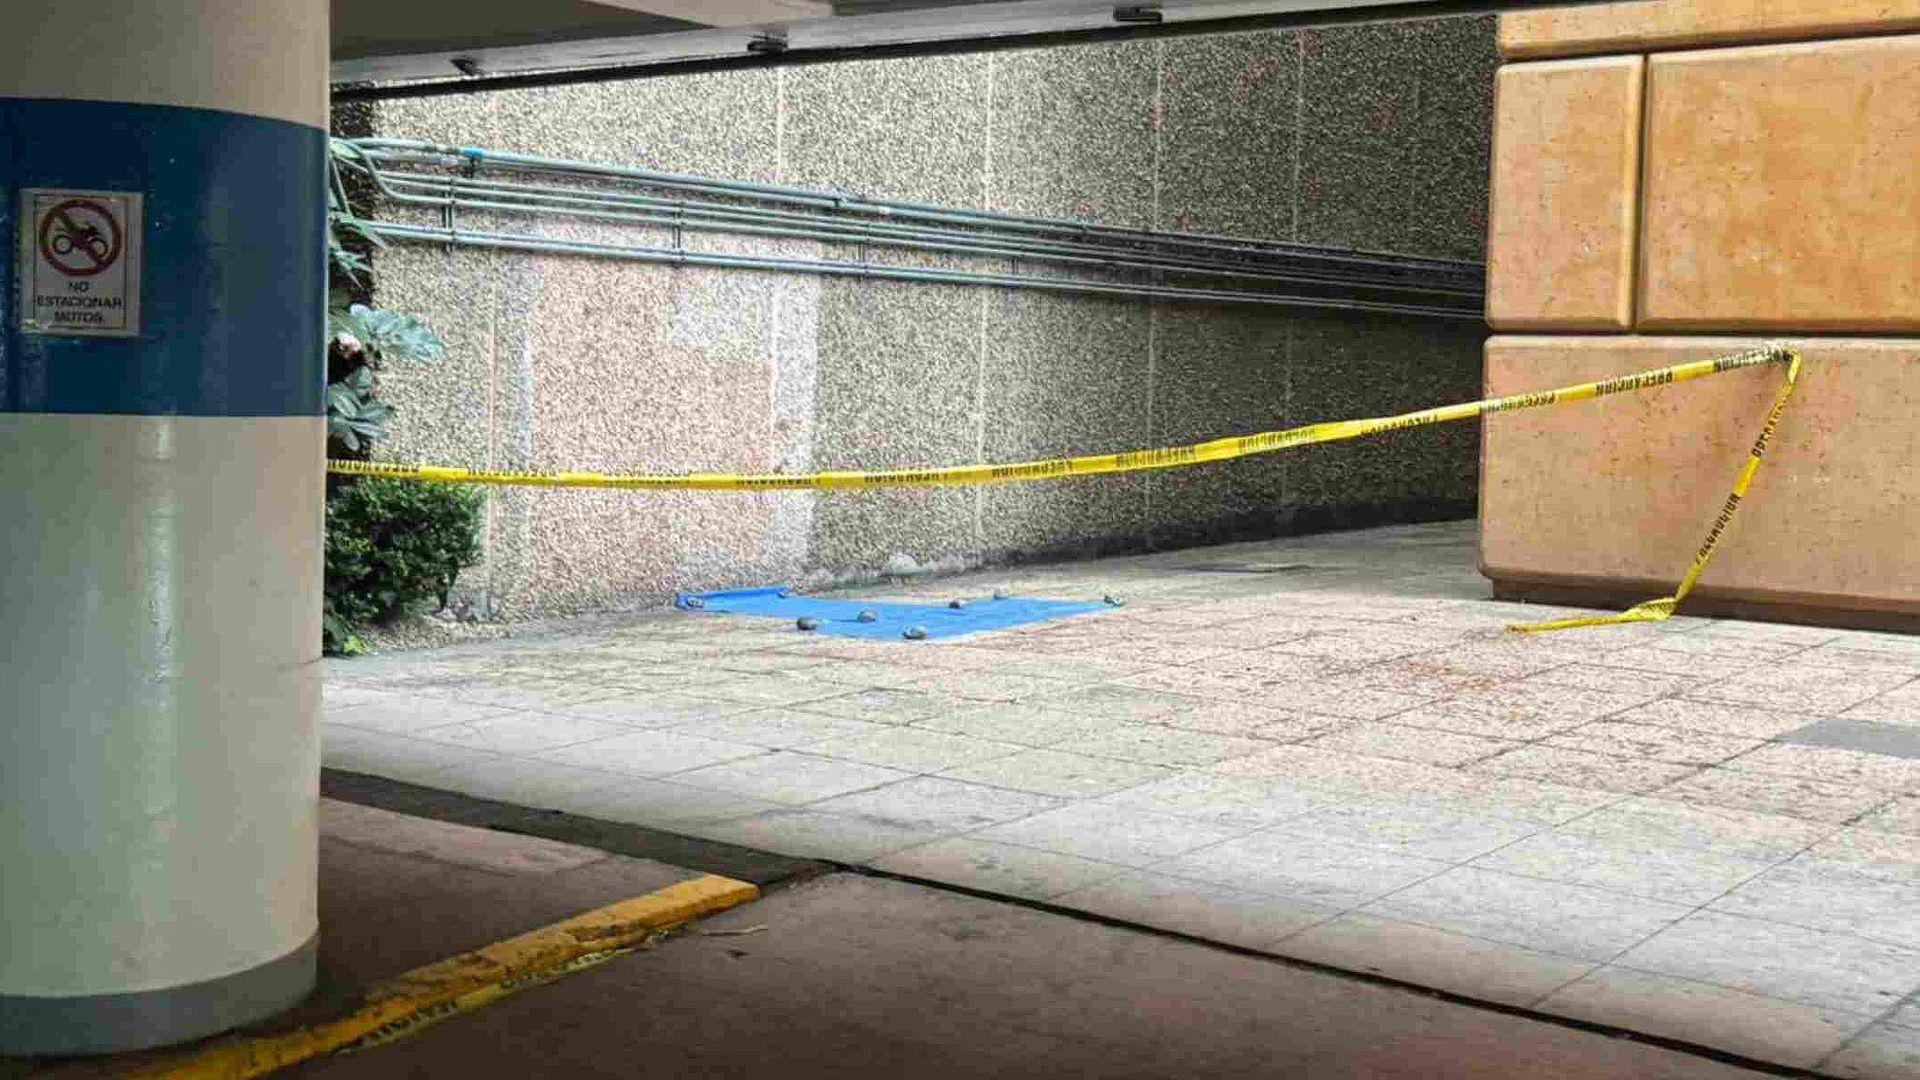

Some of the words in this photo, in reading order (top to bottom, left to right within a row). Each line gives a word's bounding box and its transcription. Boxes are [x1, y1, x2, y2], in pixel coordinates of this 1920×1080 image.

[68, 280, 90, 293] NO
[36, 294, 122, 310] ESTACIONAR
[54, 311, 103, 324] MOTOS
